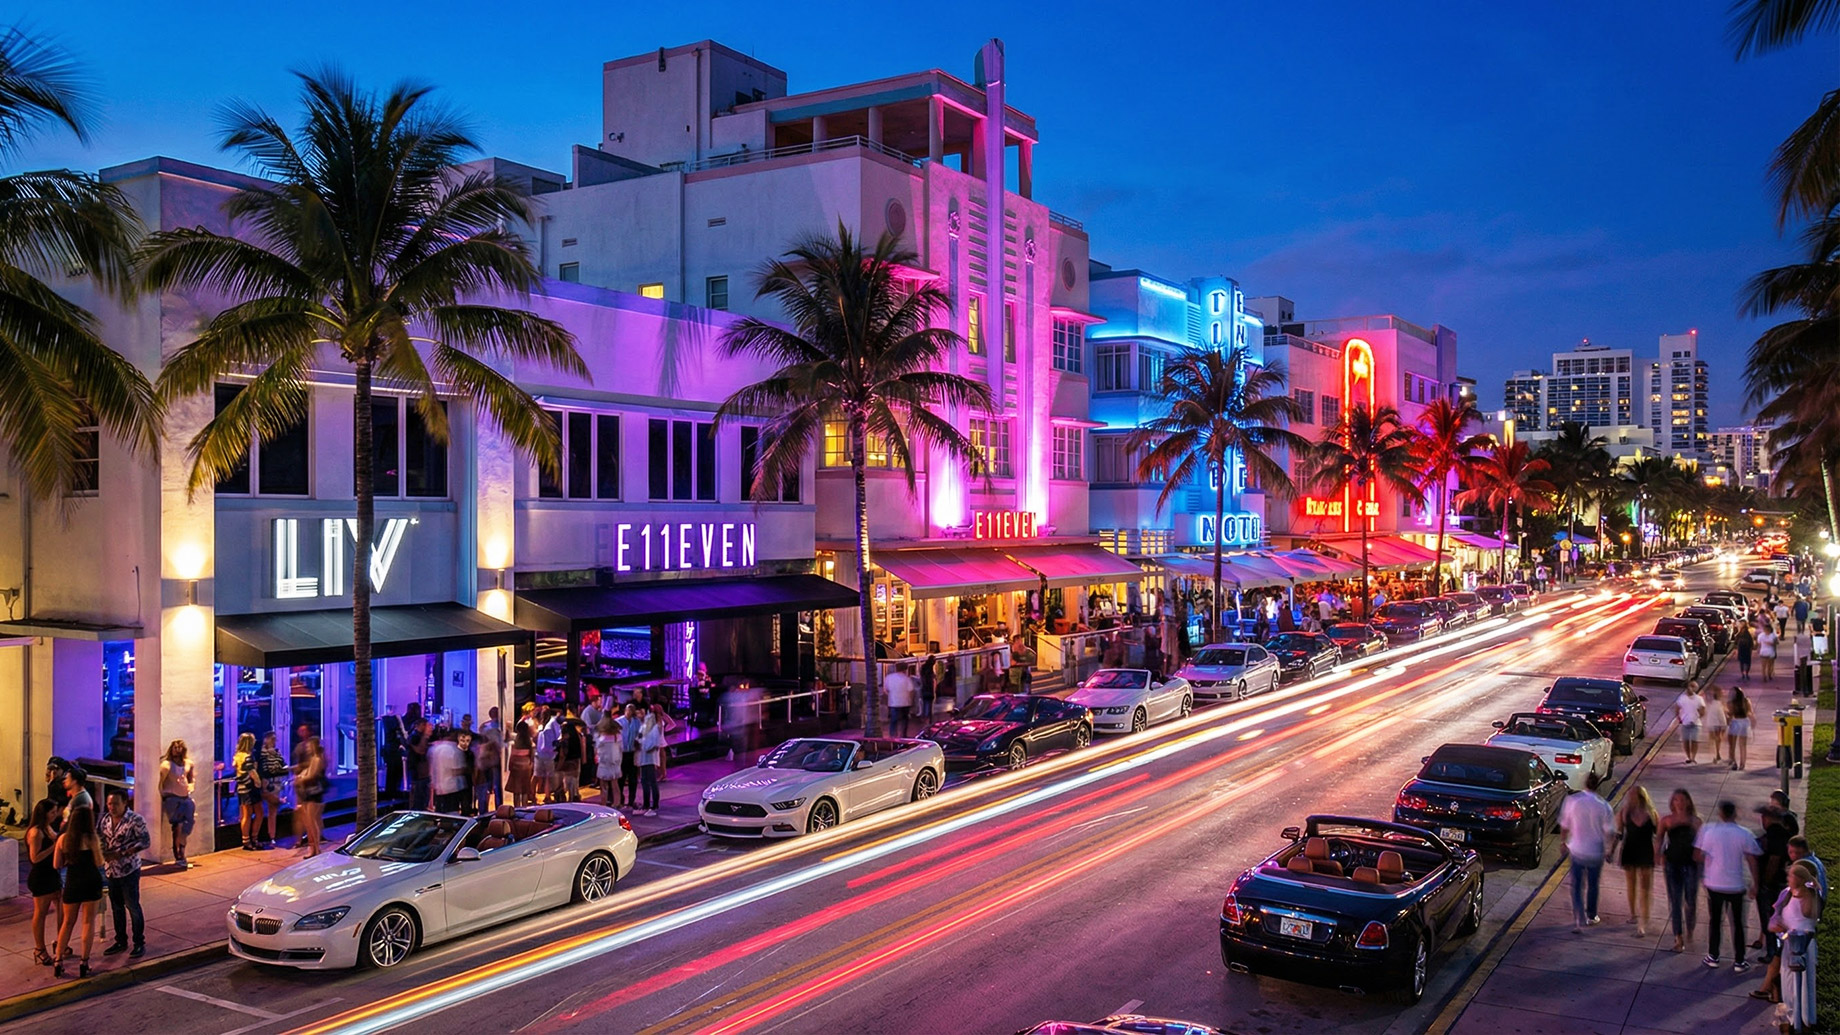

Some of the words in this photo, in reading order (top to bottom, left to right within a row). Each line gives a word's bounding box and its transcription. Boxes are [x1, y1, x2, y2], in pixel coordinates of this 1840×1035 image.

[617, 523, 755, 572] E11EVEN
[976, 511, 1038, 539] E11EVEN
[276, 518, 408, 599] LIV
